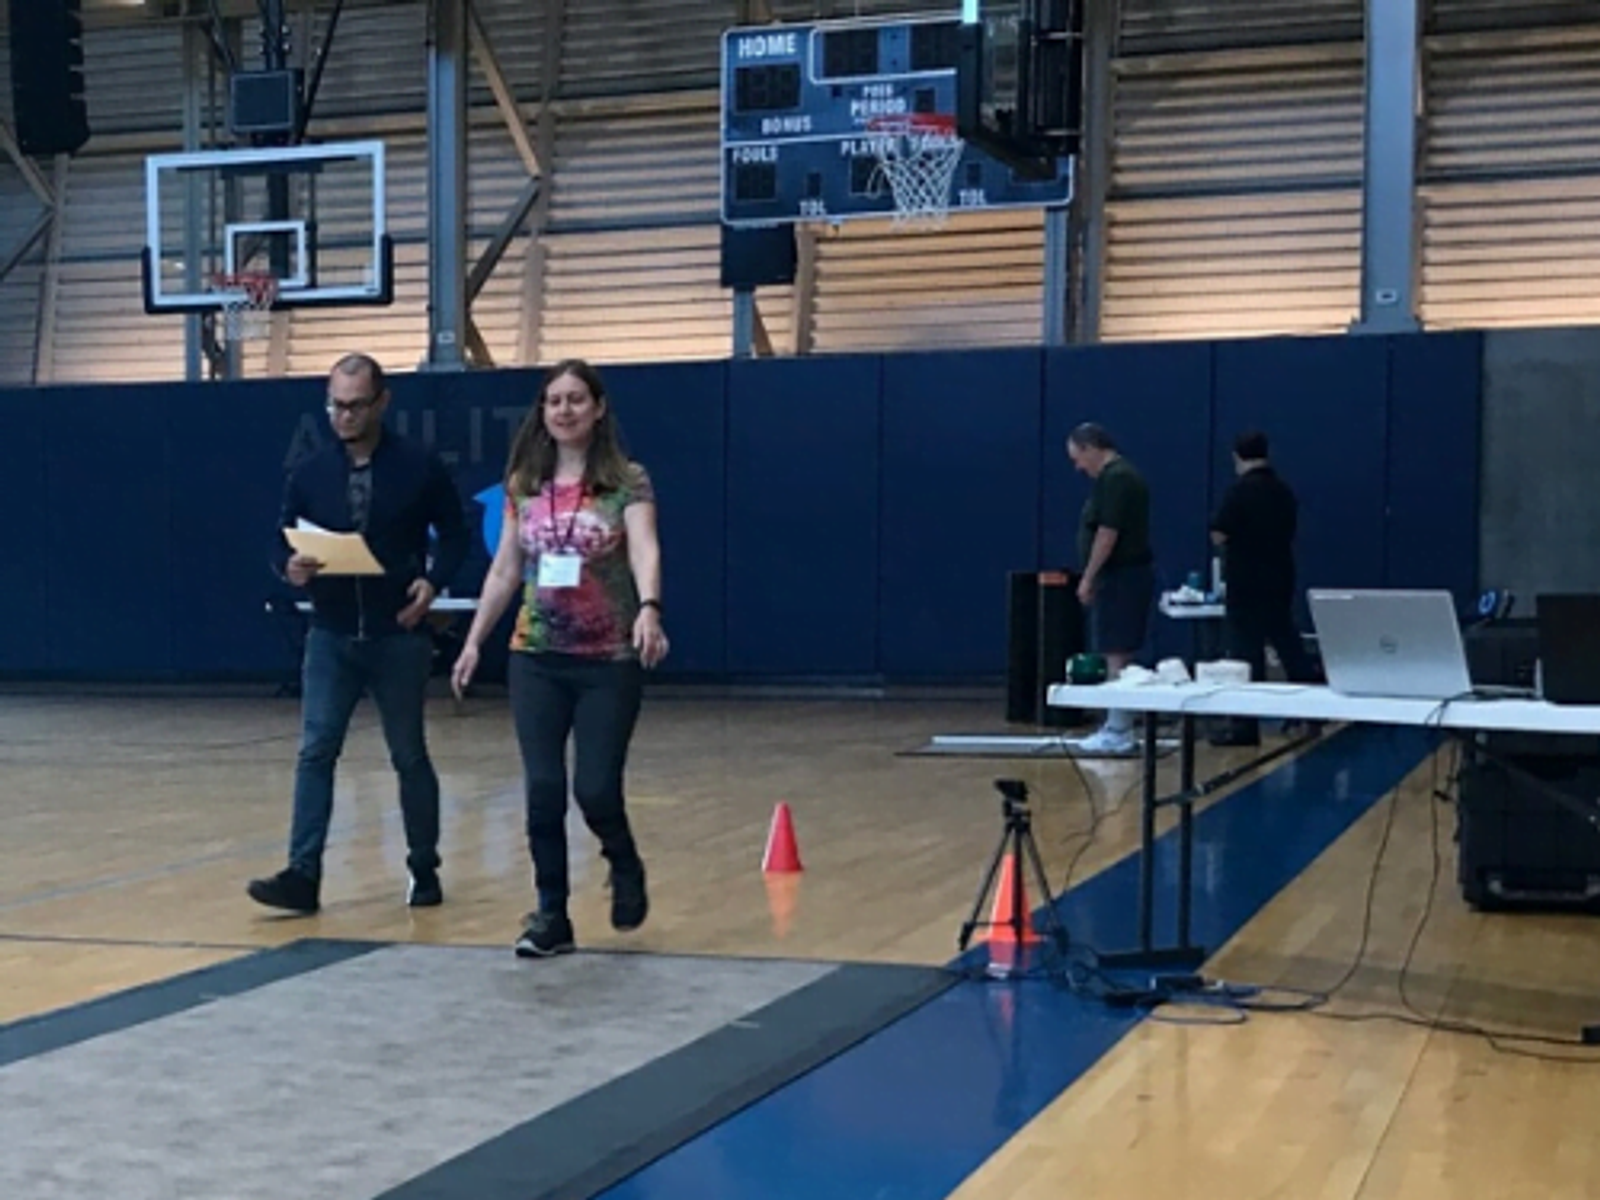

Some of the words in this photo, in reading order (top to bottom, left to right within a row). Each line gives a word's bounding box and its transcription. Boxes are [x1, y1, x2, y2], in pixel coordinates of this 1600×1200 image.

[738, 33, 797, 58] HOME
[850, 97, 907, 117] PERIOD
[761, 115, 811, 134] BONUS
